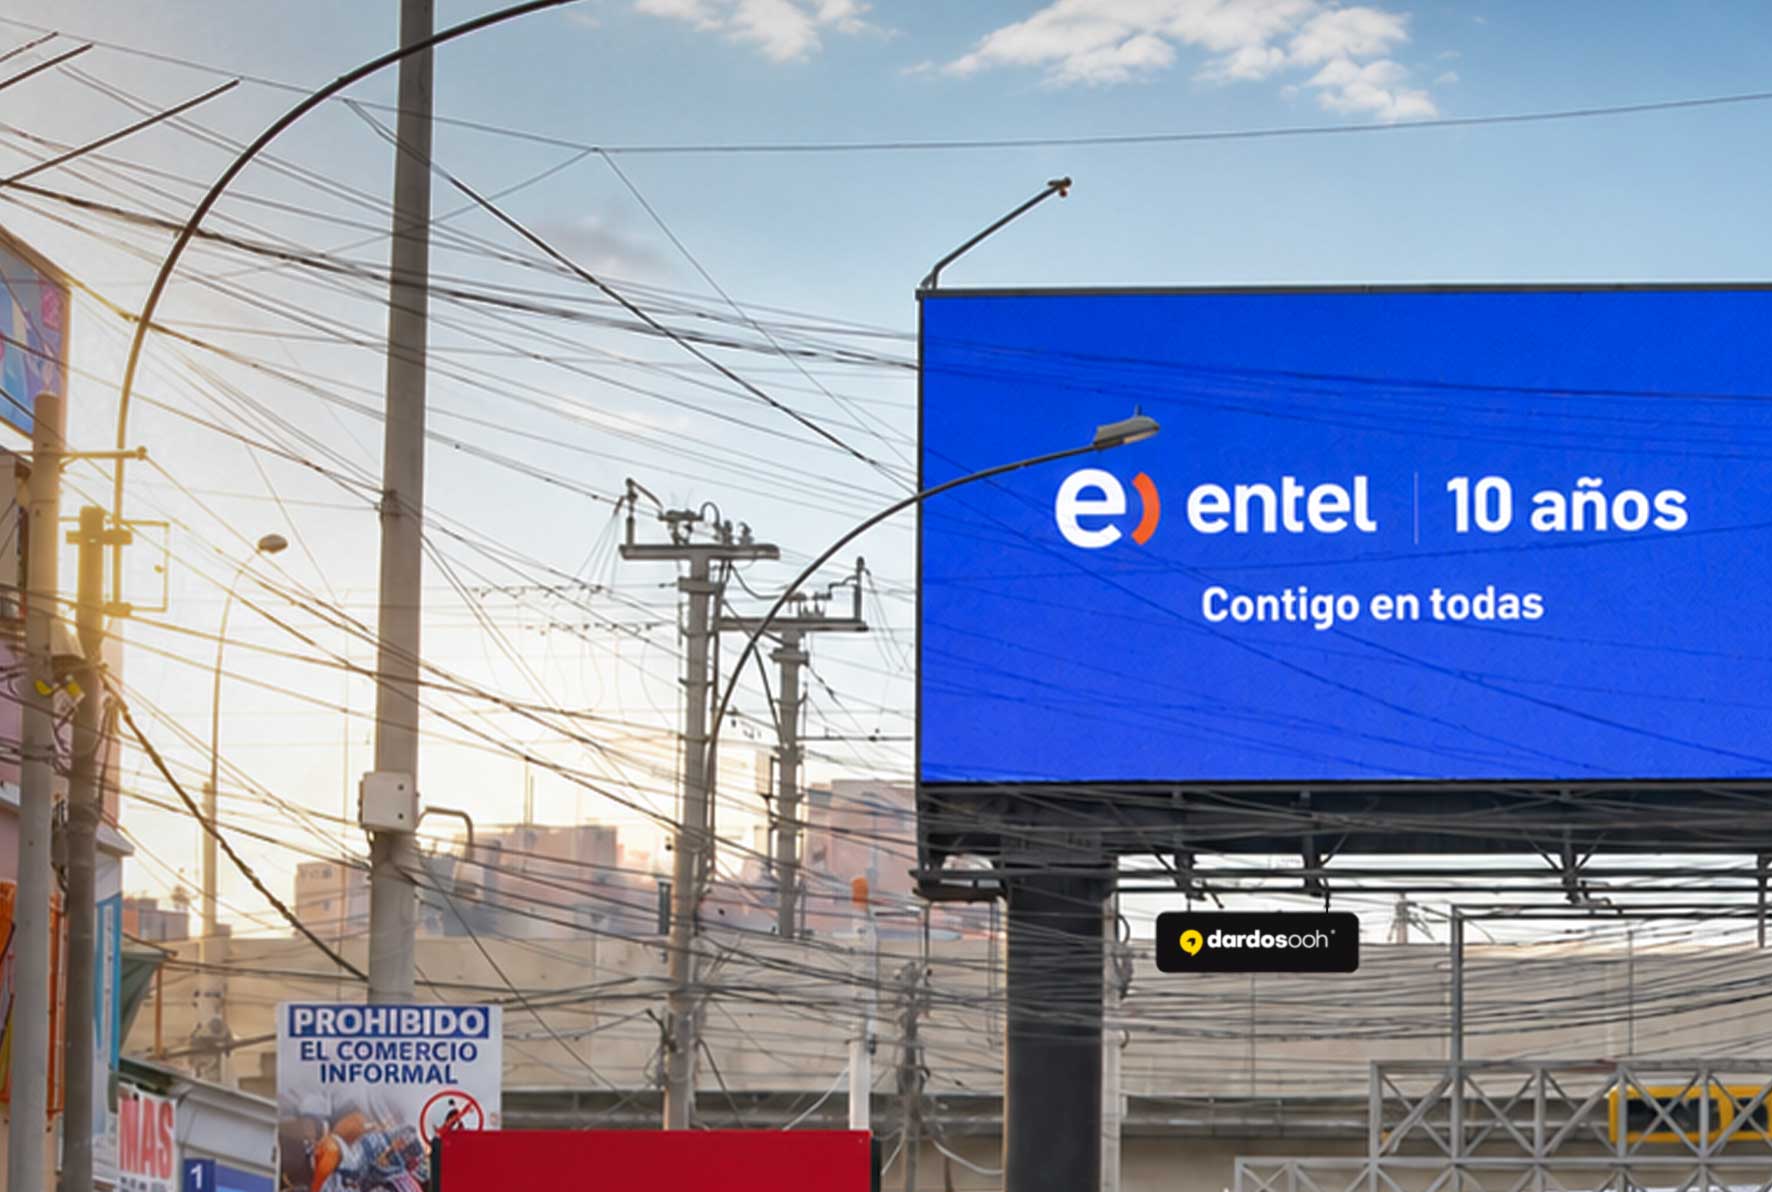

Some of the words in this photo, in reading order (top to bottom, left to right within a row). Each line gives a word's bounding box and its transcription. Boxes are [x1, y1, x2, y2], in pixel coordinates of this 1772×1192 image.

[1186, 475, 1377, 533] entel
[1446, 476, 1512, 532] 10
[1530, 477, 1688, 532] años
[1201, 586, 1360, 630] Contigo
[1369, 594, 1419, 620] en
[1428, 585, 1544, 620] todas
[1206, 929, 1329, 949] dardosooh
[293, 1009, 486, 1037] PROHIBIDO
[300, 1041, 330, 1061] EL
[336, 1041, 479, 1062] COMERCIO
[320, 1063, 458, 1085] INFORMAL
